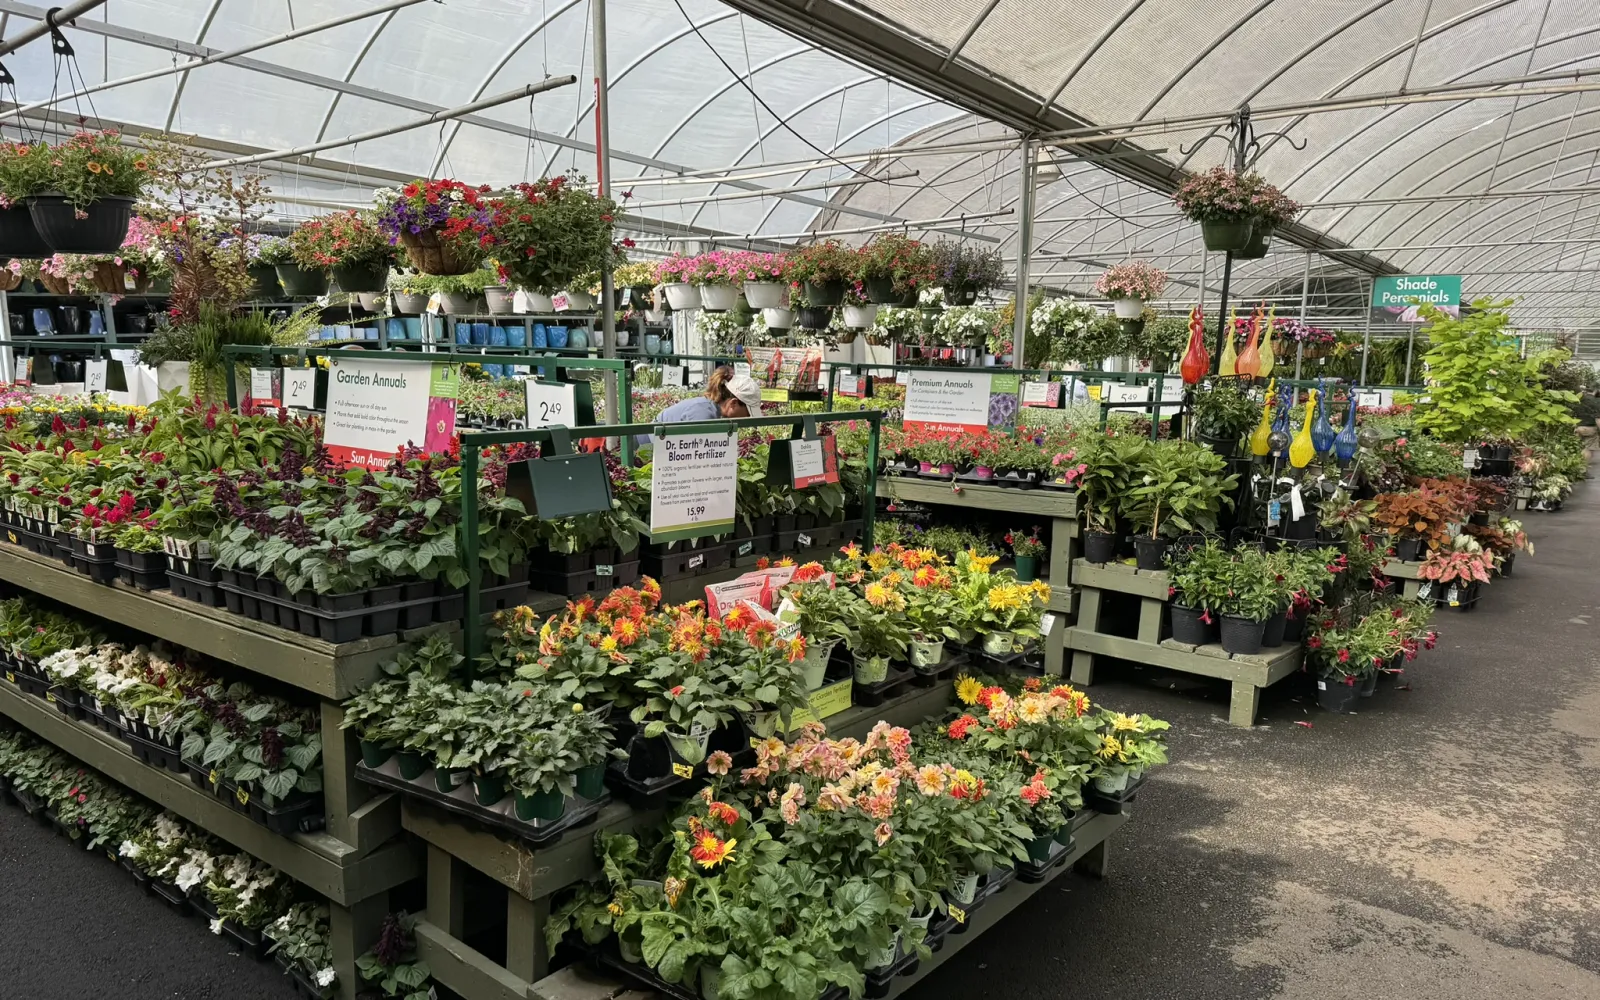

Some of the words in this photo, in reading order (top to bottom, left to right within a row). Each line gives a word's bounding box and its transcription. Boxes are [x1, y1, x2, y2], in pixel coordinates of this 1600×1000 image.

[1396, 277, 1437, 290] Shade
[1382, 290, 1449, 303] Perenials
[337, 370, 370, 386] Garden
[372, 372, 407, 389] Annuals
[912, 378, 942, 387] Premium
[944, 380, 973, 388] Annuals
[292, 381, 307, 397] 249
[540, 401, 562, 422] 249
[924, 423, 936, 431] Sun
[938, 424, 964, 432] Annuals
[666, 440, 676, 450] Dr.
[704, 437, 729, 448] Annual
[350, 450, 365, 464] Sun
[367, 453, 392, 468] Annu
[668, 451, 692, 461] Bloom
[695, 449, 726, 459] Fertilizer
[687, 506, 705, 516] 15.99
